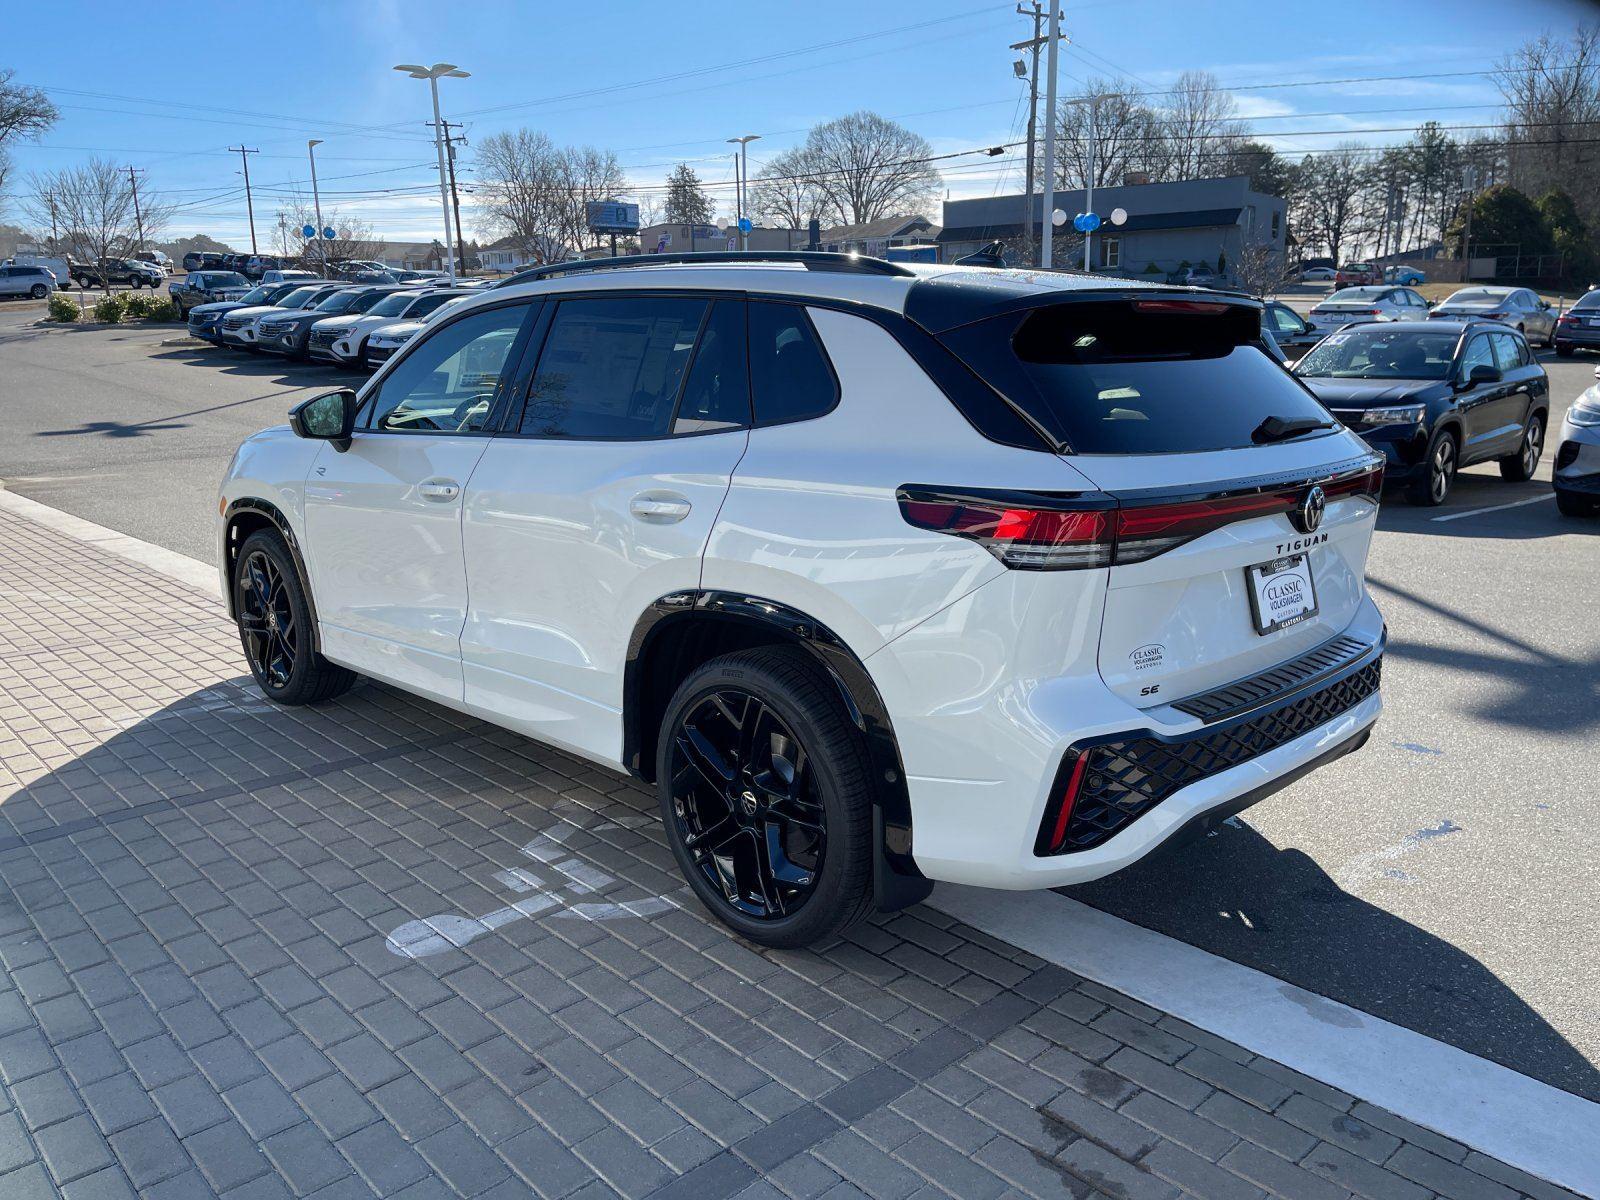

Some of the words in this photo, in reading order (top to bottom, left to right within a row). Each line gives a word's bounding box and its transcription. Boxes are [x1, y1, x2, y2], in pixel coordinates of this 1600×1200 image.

[1276, 533, 1329, 555] TIGUAN
[1268, 580, 1302, 600] CLASSIC
[1270, 593, 1304, 610] VOLKSWAGEN
[1134, 647, 1162, 659] CLASSIC
[1134, 655, 1163, 665] VOLKSWAGEN
[1140, 684, 1161, 697] SE
